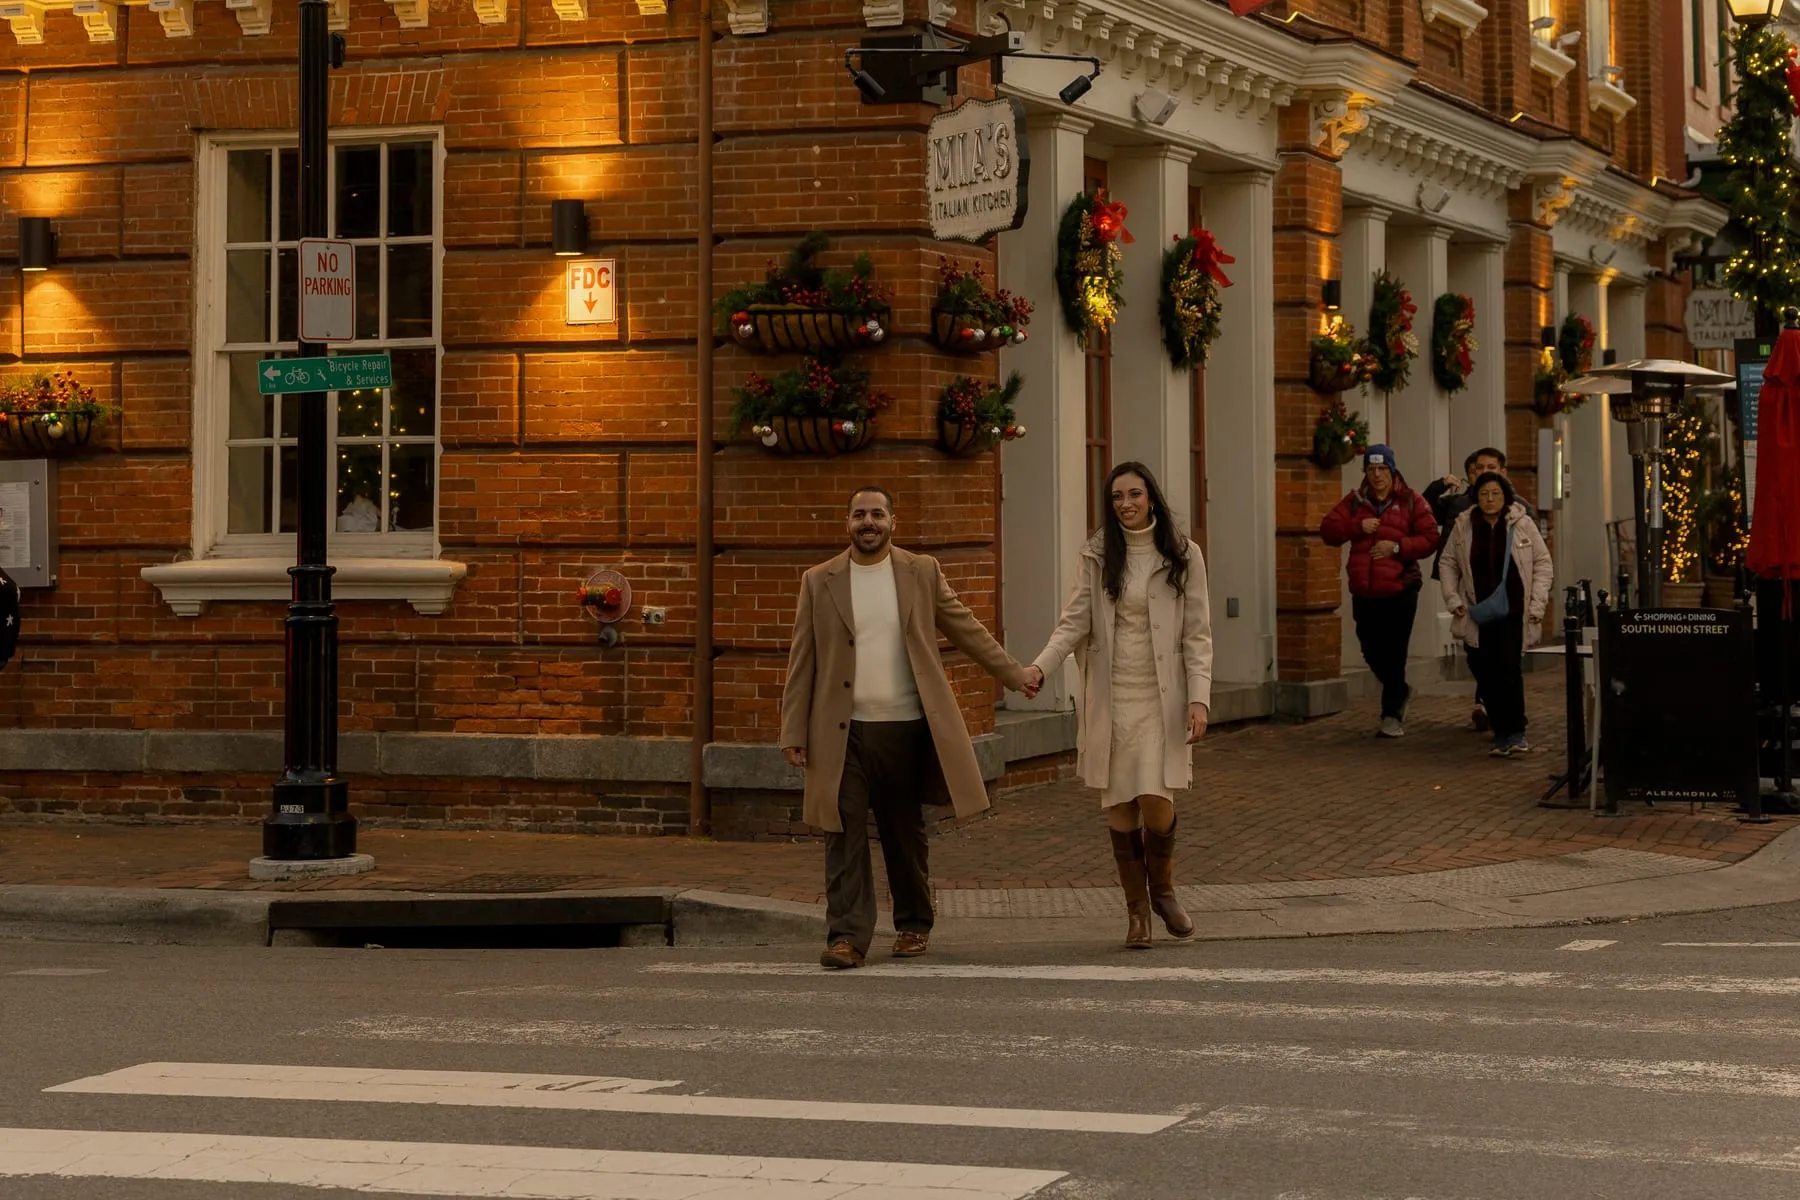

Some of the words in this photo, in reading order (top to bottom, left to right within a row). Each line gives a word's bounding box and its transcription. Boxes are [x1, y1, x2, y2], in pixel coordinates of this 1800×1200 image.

[933, 122, 1011, 192] MIA'S
[934, 195, 969, 221] ITALIAN
[972, 188, 1012, 214] KITCHEN
[317, 252, 338, 273] NO
[304, 277, 351, 296] PARKING
[570, 266, 610, 290] FDC
[329, 360, 358, 373] Bicycle
[362, 359, 387, 372] Repair
[345, 375, 353, 386] &
[356, 374, 389, 385] Services
[1643, 613, 1682, 621] SHOPPING
[1688, 613, 1717, 621] DINING
[1621, 624, 1656, 634] SOUTH
[1658, 624, 1691, 634] UNION
[1693, 624, 1730, 634] STREET
